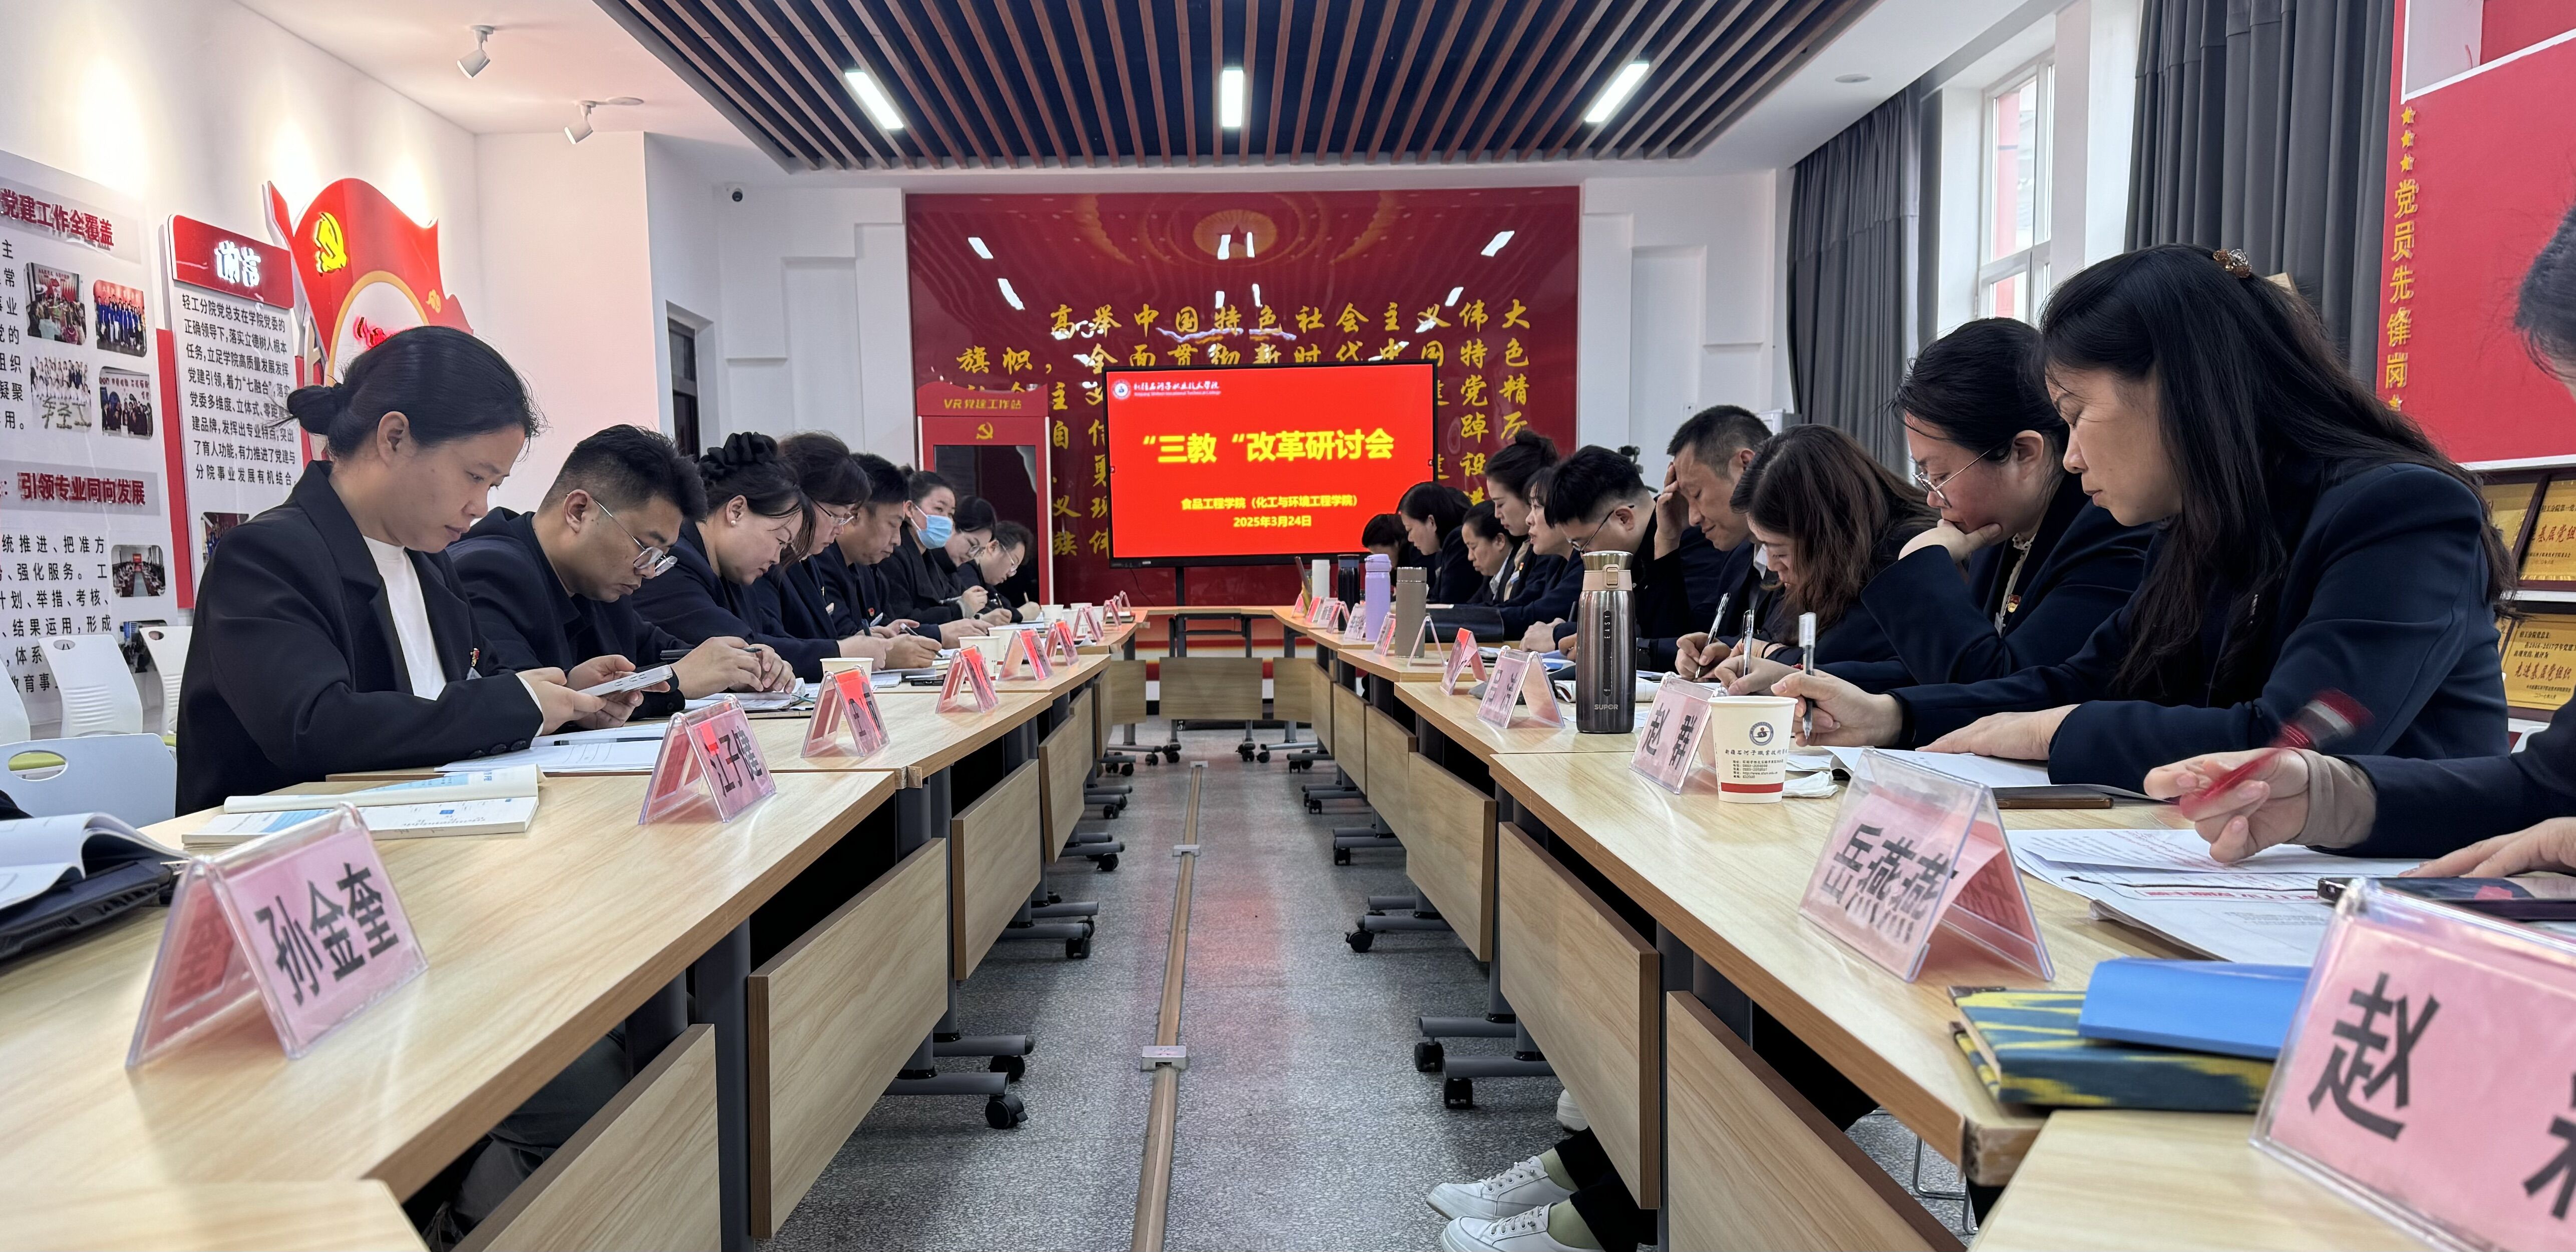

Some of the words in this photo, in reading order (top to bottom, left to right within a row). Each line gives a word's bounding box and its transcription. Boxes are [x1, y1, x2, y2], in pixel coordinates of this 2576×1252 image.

[0, 188, 114, 247] 党建工作全覆盖
[2385, 179, 2419, 388] 党员先锋岗
[182, 293, 285, 332] 轻工分院党总支在学院党委的
[1051, 298, 1530, 340] 高举中国特色社会主义伟大
[184, 318, 287, 354] 正确领导下，落实立德树人根本
[186, 343, 289, 377] 任务，立足学院高质量发展发挥
[190, 391, 287, 420] 党委多维度、立体式、零距
[194, 440, 295, 465] 了育人功能，有力推进了党建与
[1181, 494, 1358, 511] 食品工程学院（化工与环境工程学院）
[1233, 516, 1312, 528] 2025年3月24日
[2530, 524, 2576, 543] 基层党组
[1642, 702, 1698, 770] 赵群
[1820, 823, 1959, 944] 岳燕燕
[254, 863, 399, 1006] 孙金奎
